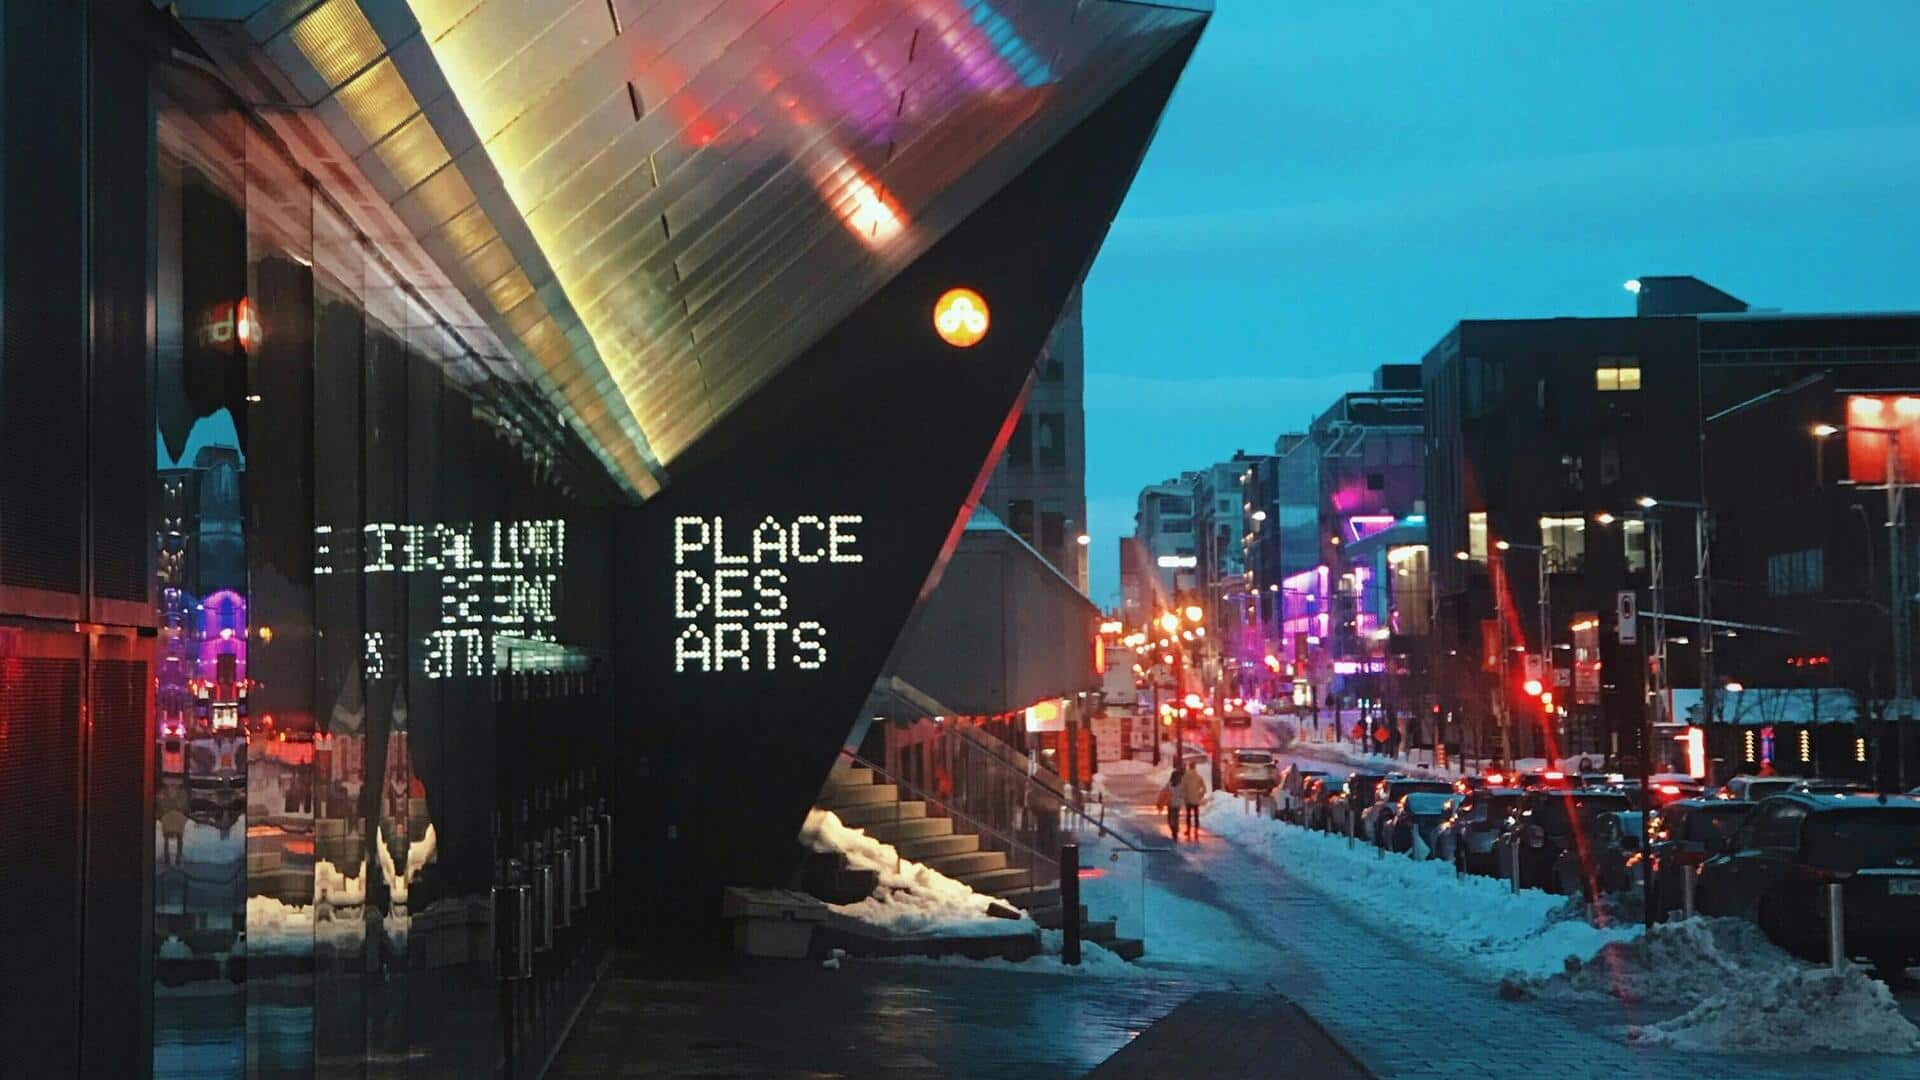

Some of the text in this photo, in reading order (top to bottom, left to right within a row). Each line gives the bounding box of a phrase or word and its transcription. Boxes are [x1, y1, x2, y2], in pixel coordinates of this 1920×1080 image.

[675, 515, 863, 565] PLACE
[675, 568, 788, 618] DES
[675, 621, 827, 672] ARTS
